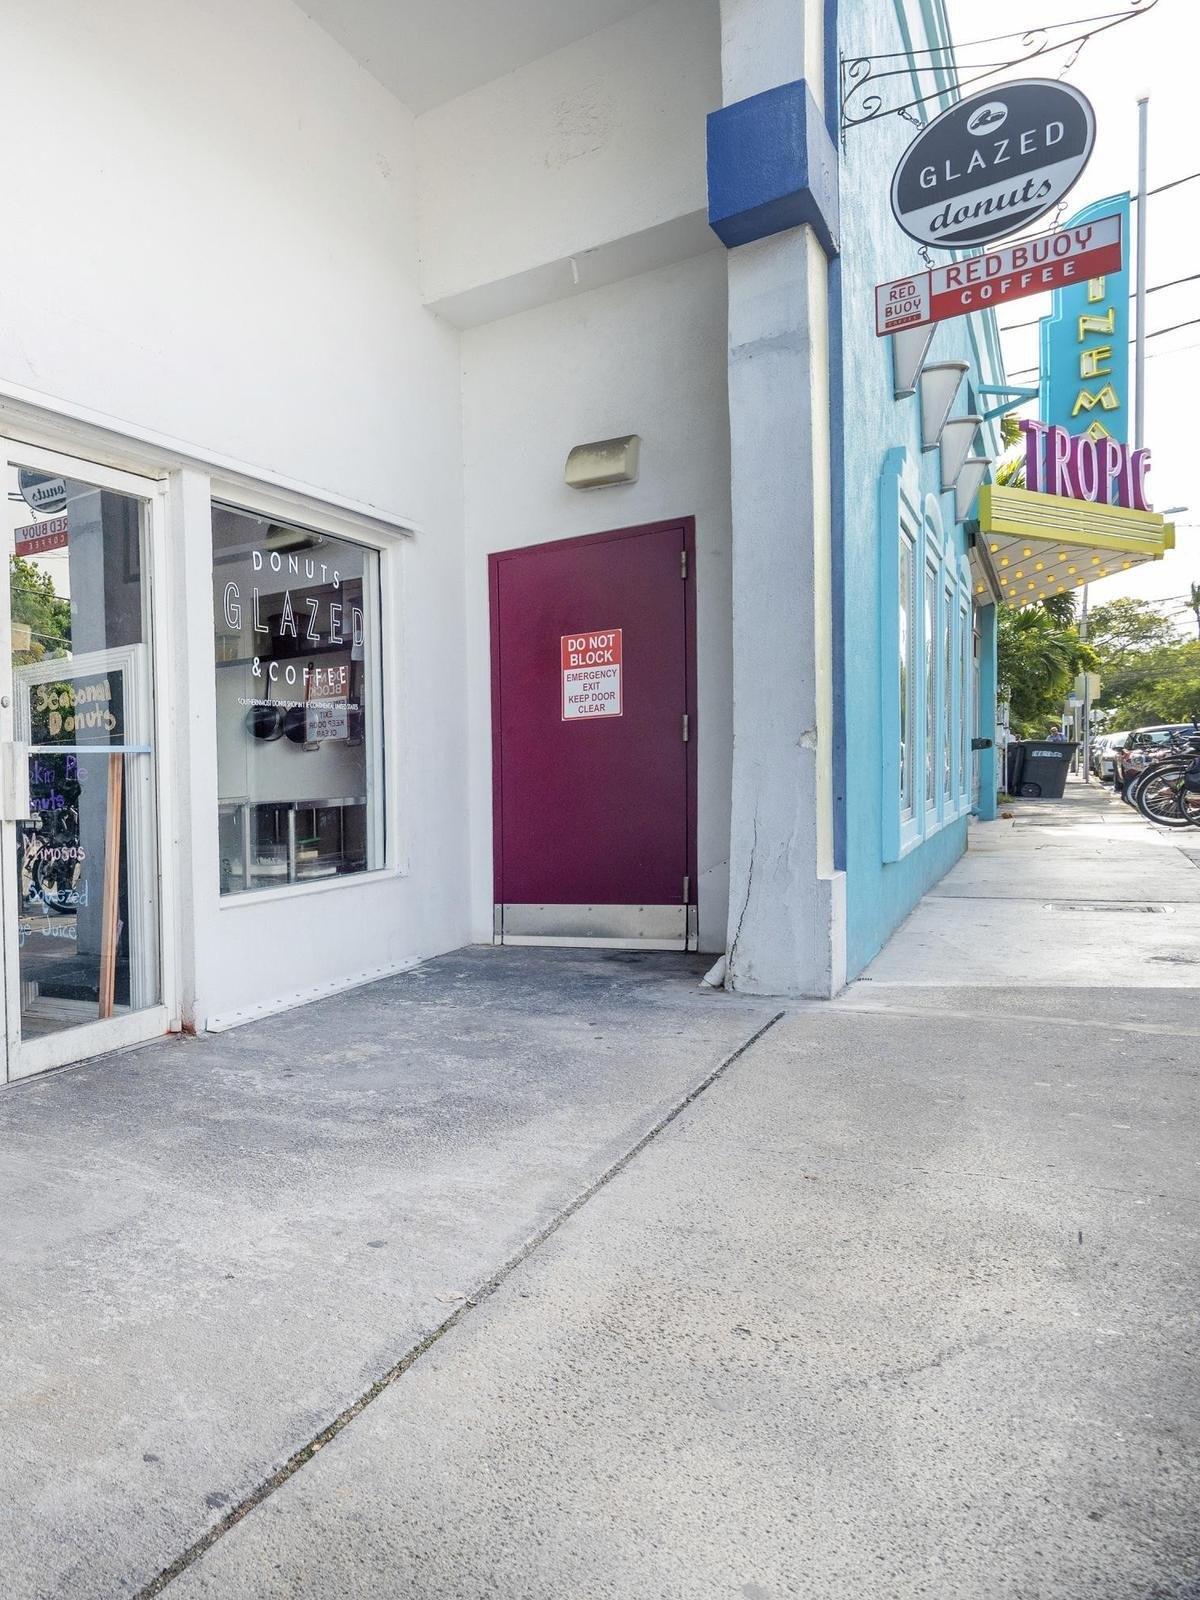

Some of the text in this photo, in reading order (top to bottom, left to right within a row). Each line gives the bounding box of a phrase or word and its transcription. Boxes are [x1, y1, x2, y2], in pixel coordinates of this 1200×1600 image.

[919, 121, 1065, 189] GLAZED
[929, 176, 1052, 234] donuts
[946, 227, 1092, 289] RED BUOY
[890, 285, 915, 301] RED
[961, 261, 1075, 305] COFFEE
[885, 298, 921, 317] BUOY
[1019, 419, 1153, 512] TROPIC
[252, 551, 340, 589] DONUTS
[223, 582, 364, 647] GLAZED
[568, 634, 615, 652] DO NOT
[252, 657, 346, 686] & COFFEE
[570, 650, 613, 666] BLOCK
[566, 669, 617, 682] EMERGENCY
[582, 682, 600, 691] EXIT
[37, 680, 111, 712] Seasonal
[568, 691, 615, 704] KEEP DOOR
[578, 703, 605, 714] CLEAR
[49, 703, 116, 735] Donuts
[66, 755, 88, 781] Pie
[22, 833, 86, 861] Mimosas
[42, 914, 78, 940] Juice
